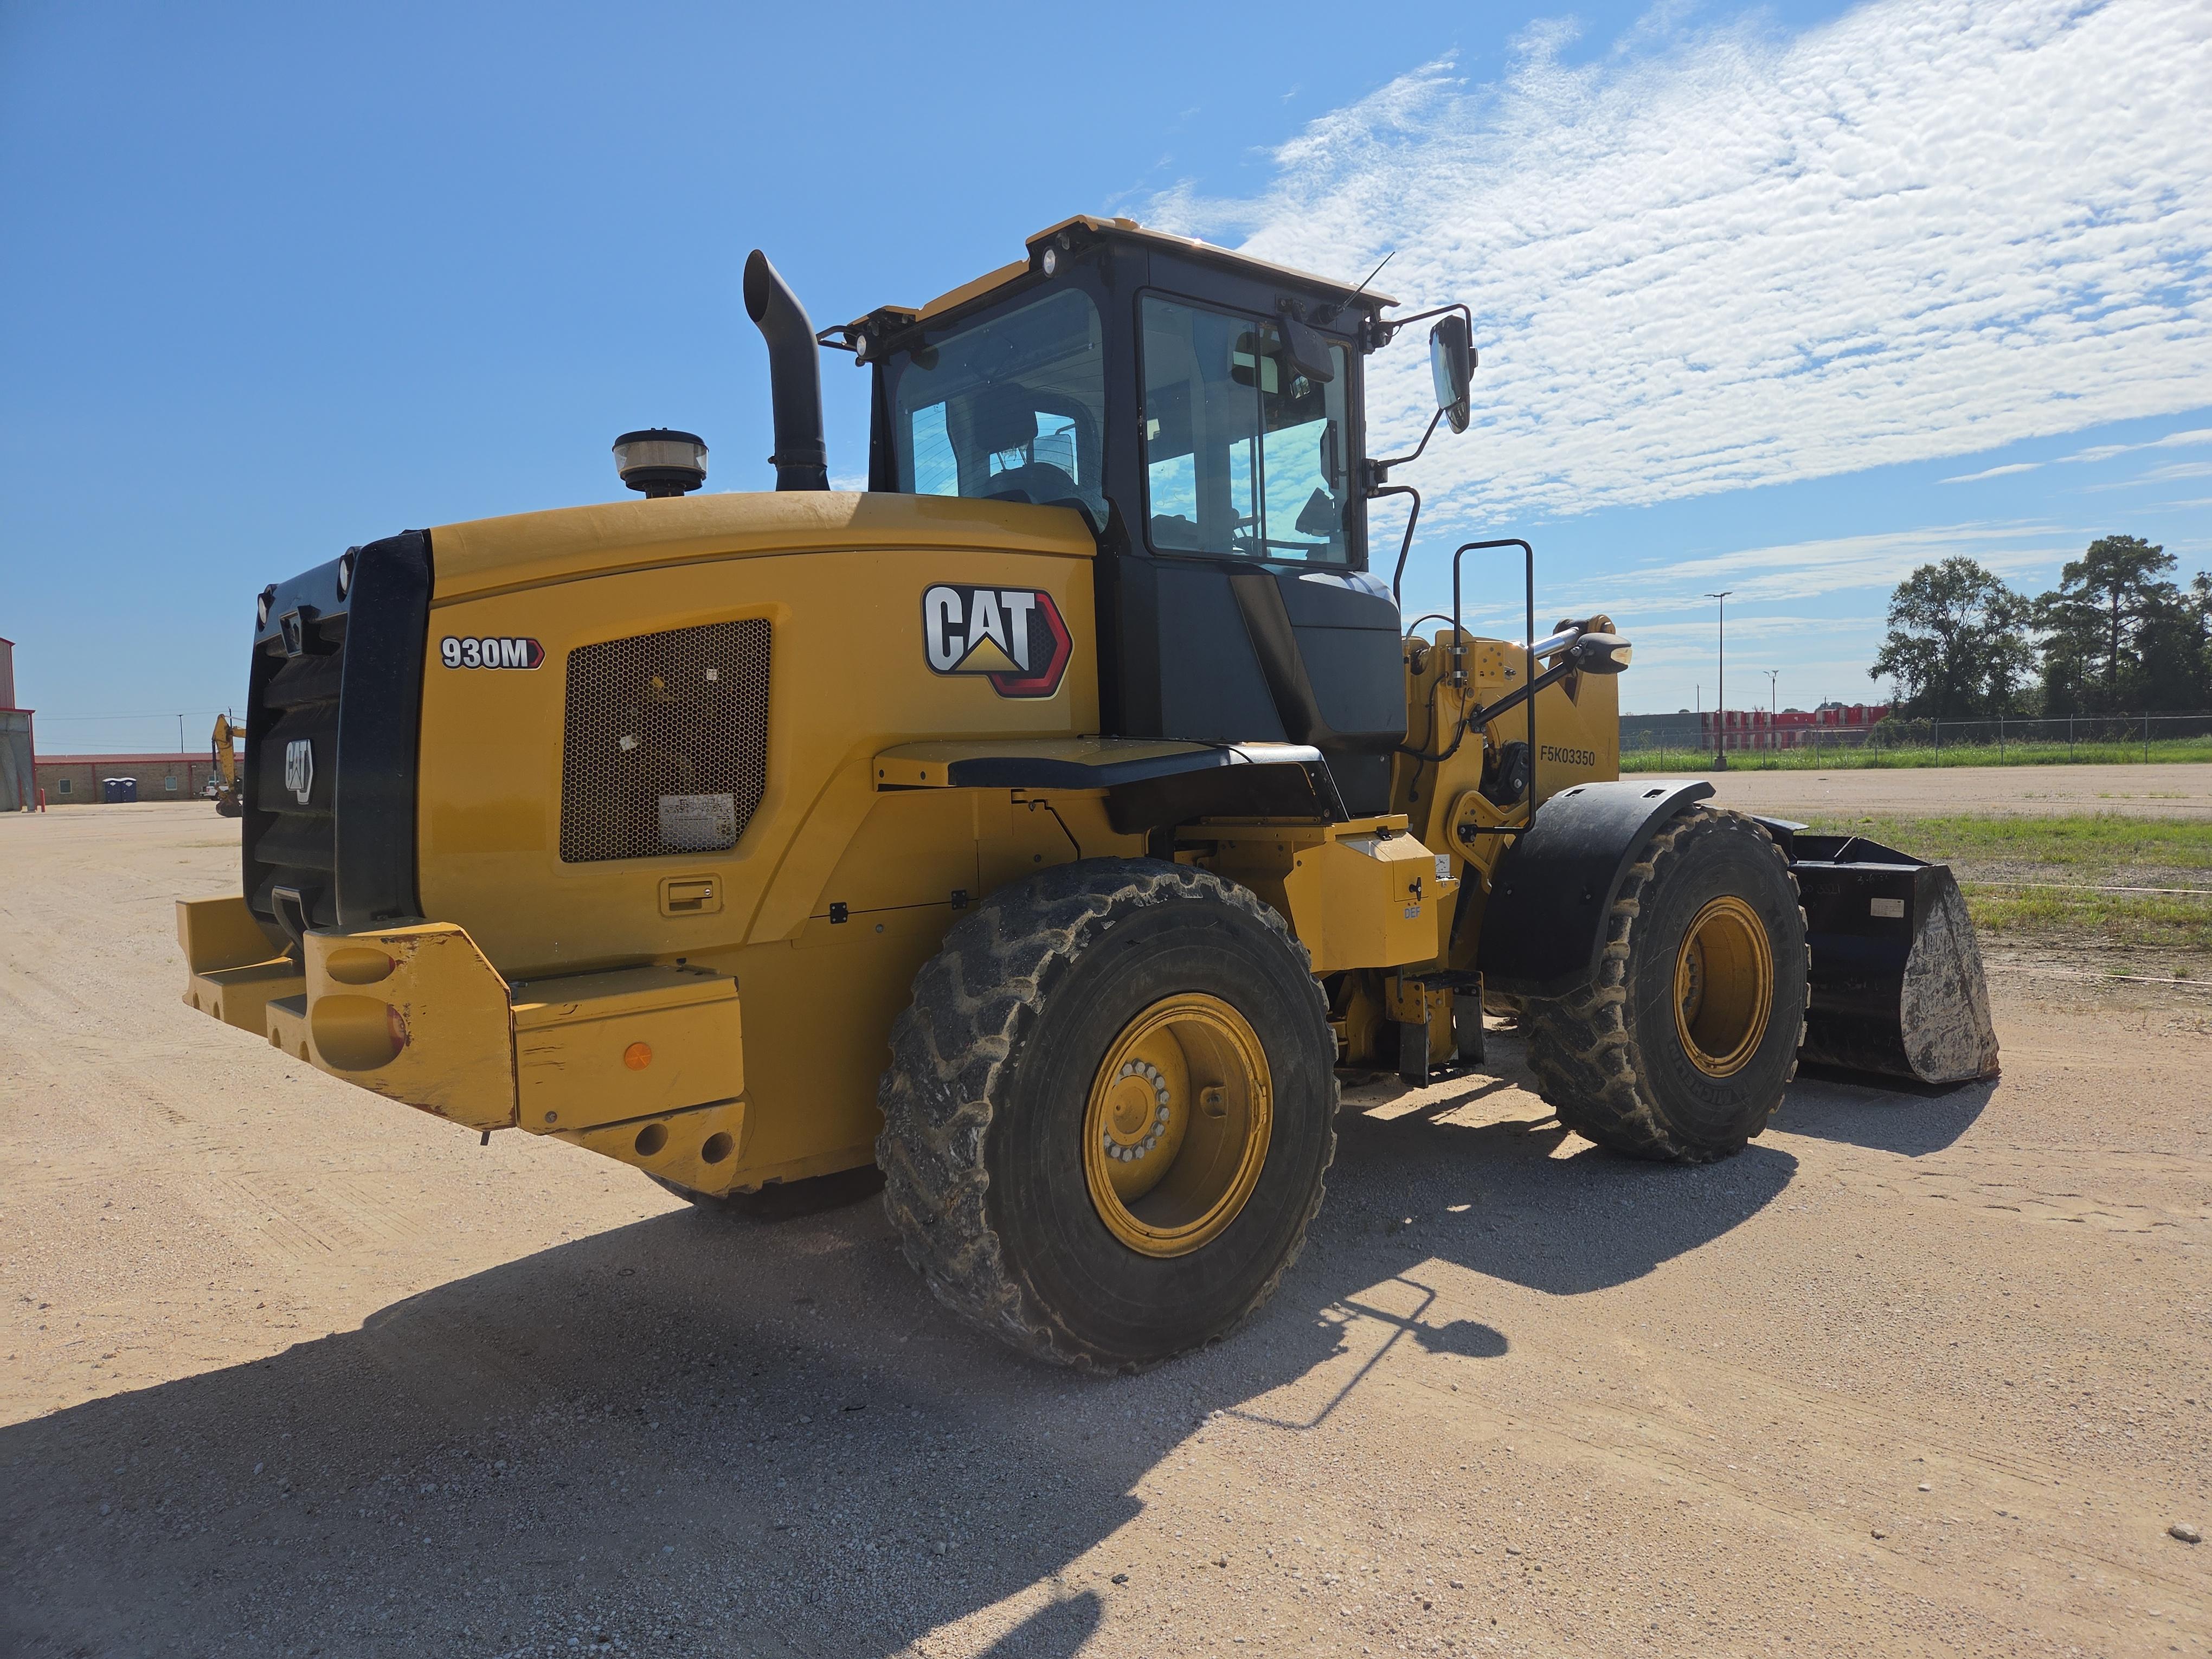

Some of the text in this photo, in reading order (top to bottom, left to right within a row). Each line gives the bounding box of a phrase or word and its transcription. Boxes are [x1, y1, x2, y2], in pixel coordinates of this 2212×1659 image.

[925, 587, 1035, 671] CAT
[442, 638, 528, 667] 930M
[286, 742, 307, 789] CAT
[1540, 745, 1595, 767] F5K03350
[1404, 906, 1420, 919] DEF
[1668, 1040, 1732, 1105] MICHELIN
